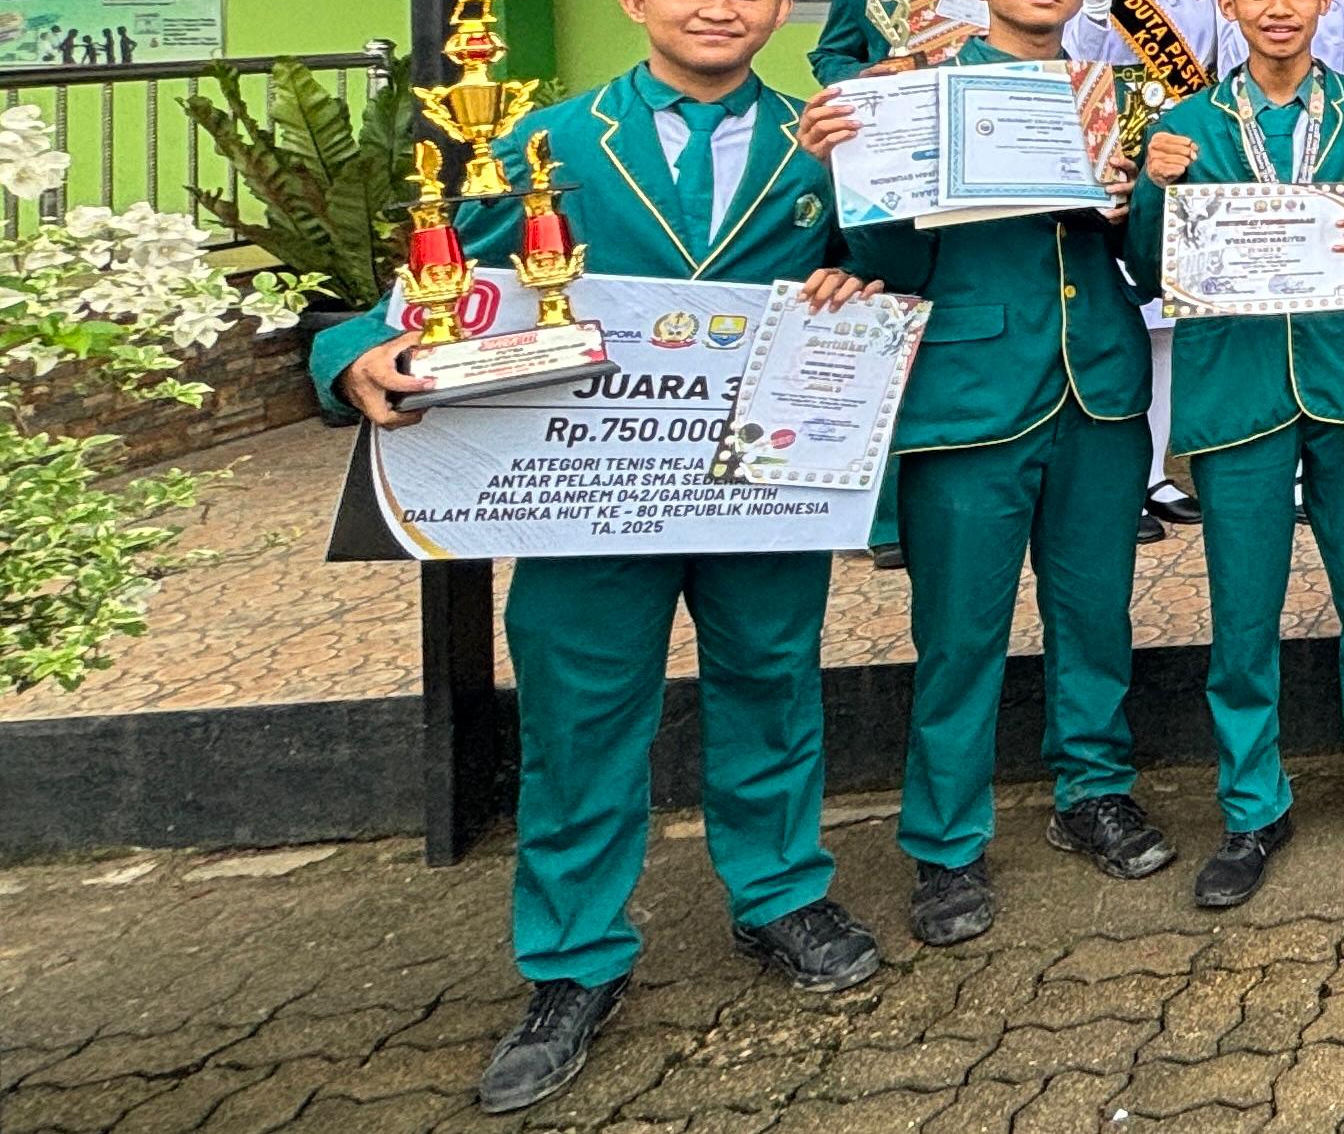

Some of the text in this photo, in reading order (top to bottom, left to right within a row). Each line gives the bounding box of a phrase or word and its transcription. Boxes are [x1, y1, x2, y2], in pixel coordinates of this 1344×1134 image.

[1133, 29, 1174, 80] KOTA
[573, 374, 742, 401] JUARA 3
[545, 417, 726, 448] Rp.750.000
[511, 457, 705, 471] KATEGORI TENIS MEJA
[487, 474, 551, 488] ANTAR
[555, 473, 641, 488] PELAJAR
[642, 473, 682, 487] SMA
[477, 487, 778, 505] PIALA DANREM 042/GARUDA PUTIH
[402, 508, 471, 523] DALAM
[474, 507, 551, 522] RANGKA
[556, 506, 593, 520] HUT
[597, 505, 622, 519] KE
[636, 504, 658, 517] 80
[662, 503, 745, 517] REPUBLIK
[746, 502, 829, 515] INDONESIA
[591, 520, 665, 535] TA. 2025
